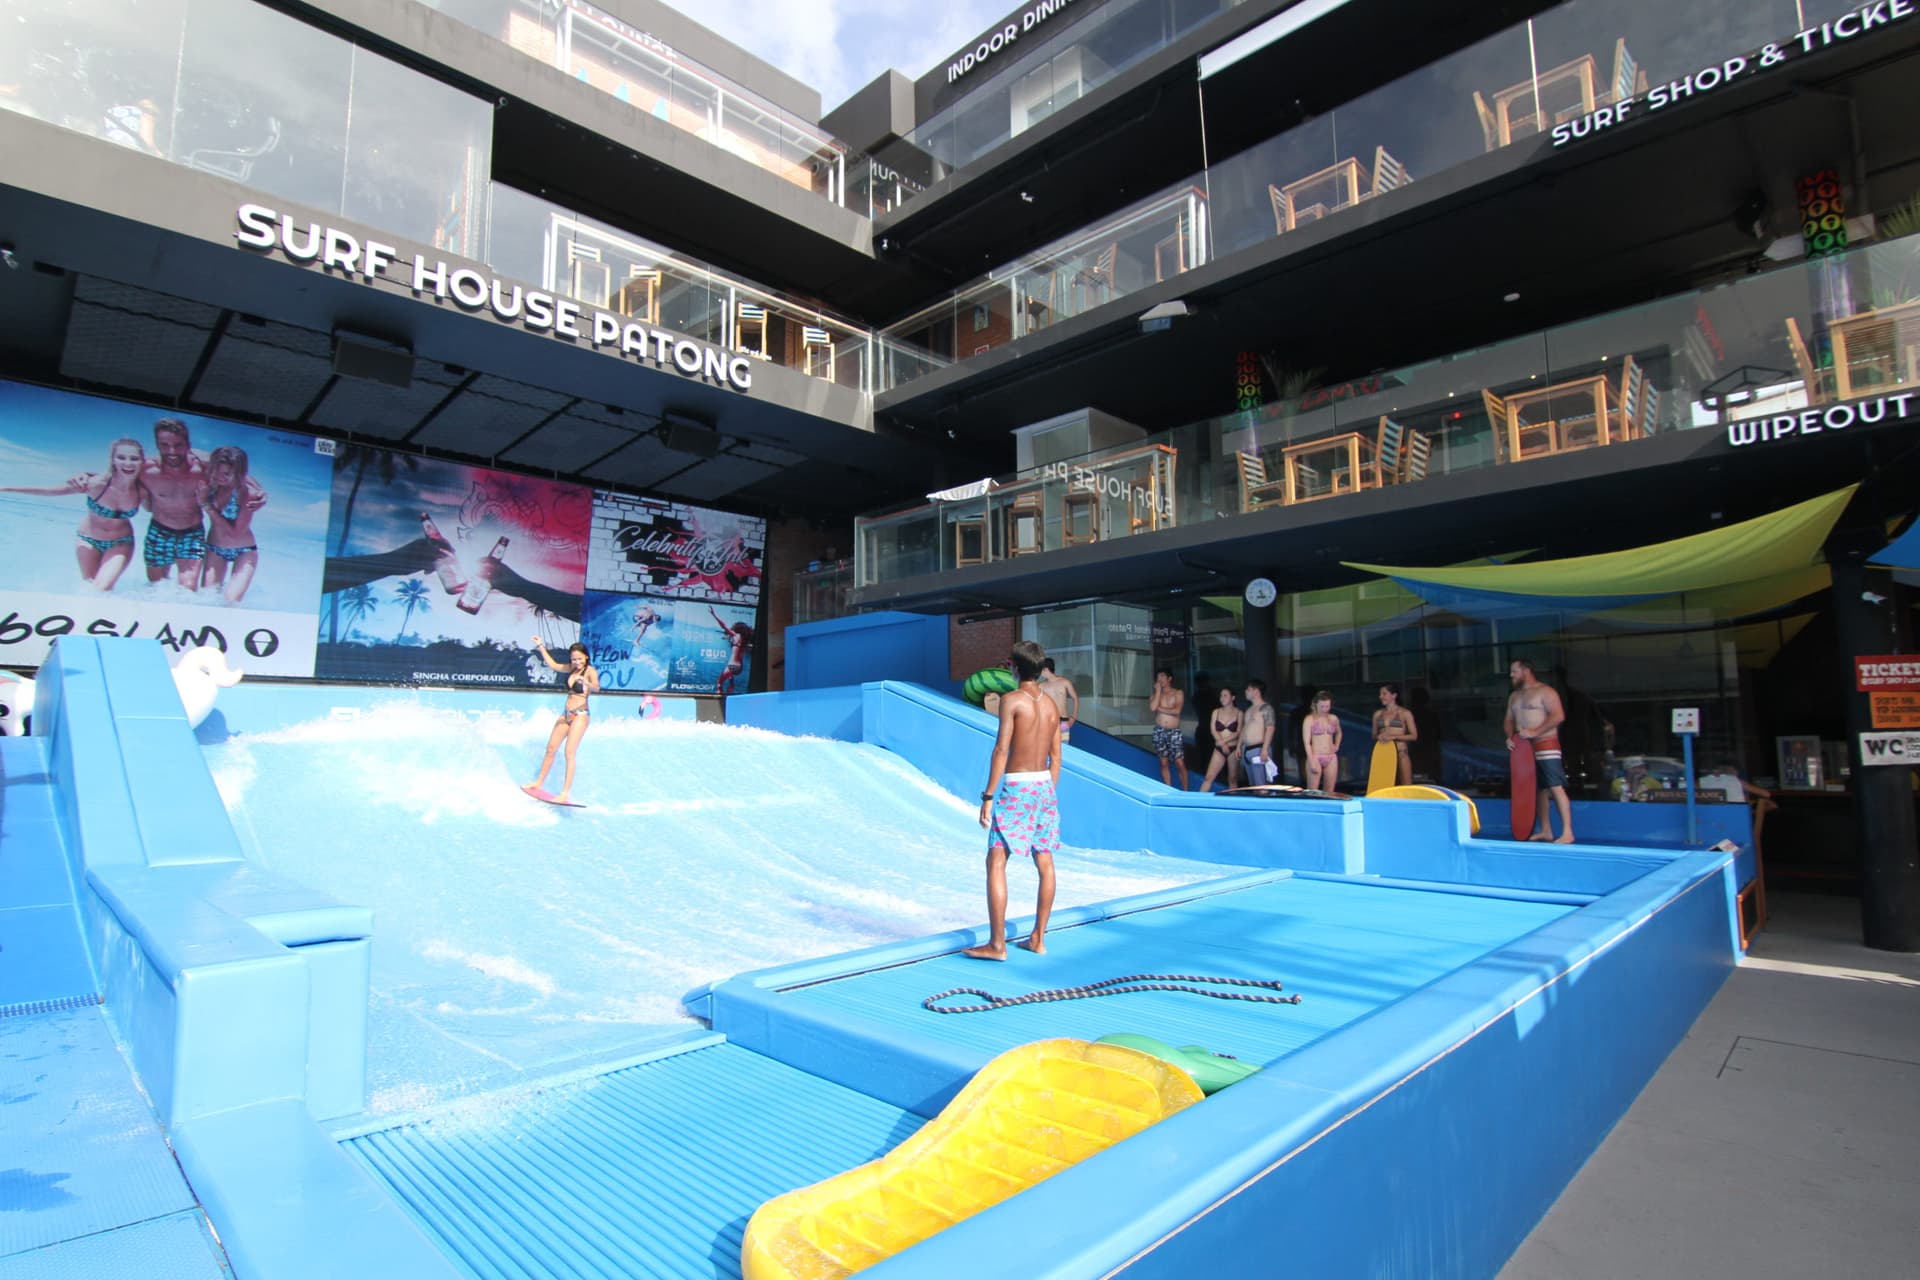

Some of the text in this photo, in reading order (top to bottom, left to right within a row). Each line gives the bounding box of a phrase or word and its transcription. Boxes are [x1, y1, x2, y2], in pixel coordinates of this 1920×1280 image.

[947, 24, 1019, 84] INDOOR
[1551, 97, 1635, 147] SURF
[1647, 56, 1747, 110] SHOP
[1759, 42, 1786, 67] &
[236, 203, 752, 391] SURF HOUSE PATONG
[1727, 393, 1914, 447] WIPEOUT
[86, 618, 229, 655] SAM
[412, 671, 515, 682] SINGHA CORPORATION
[1863, 738, 1904, 756] WC
